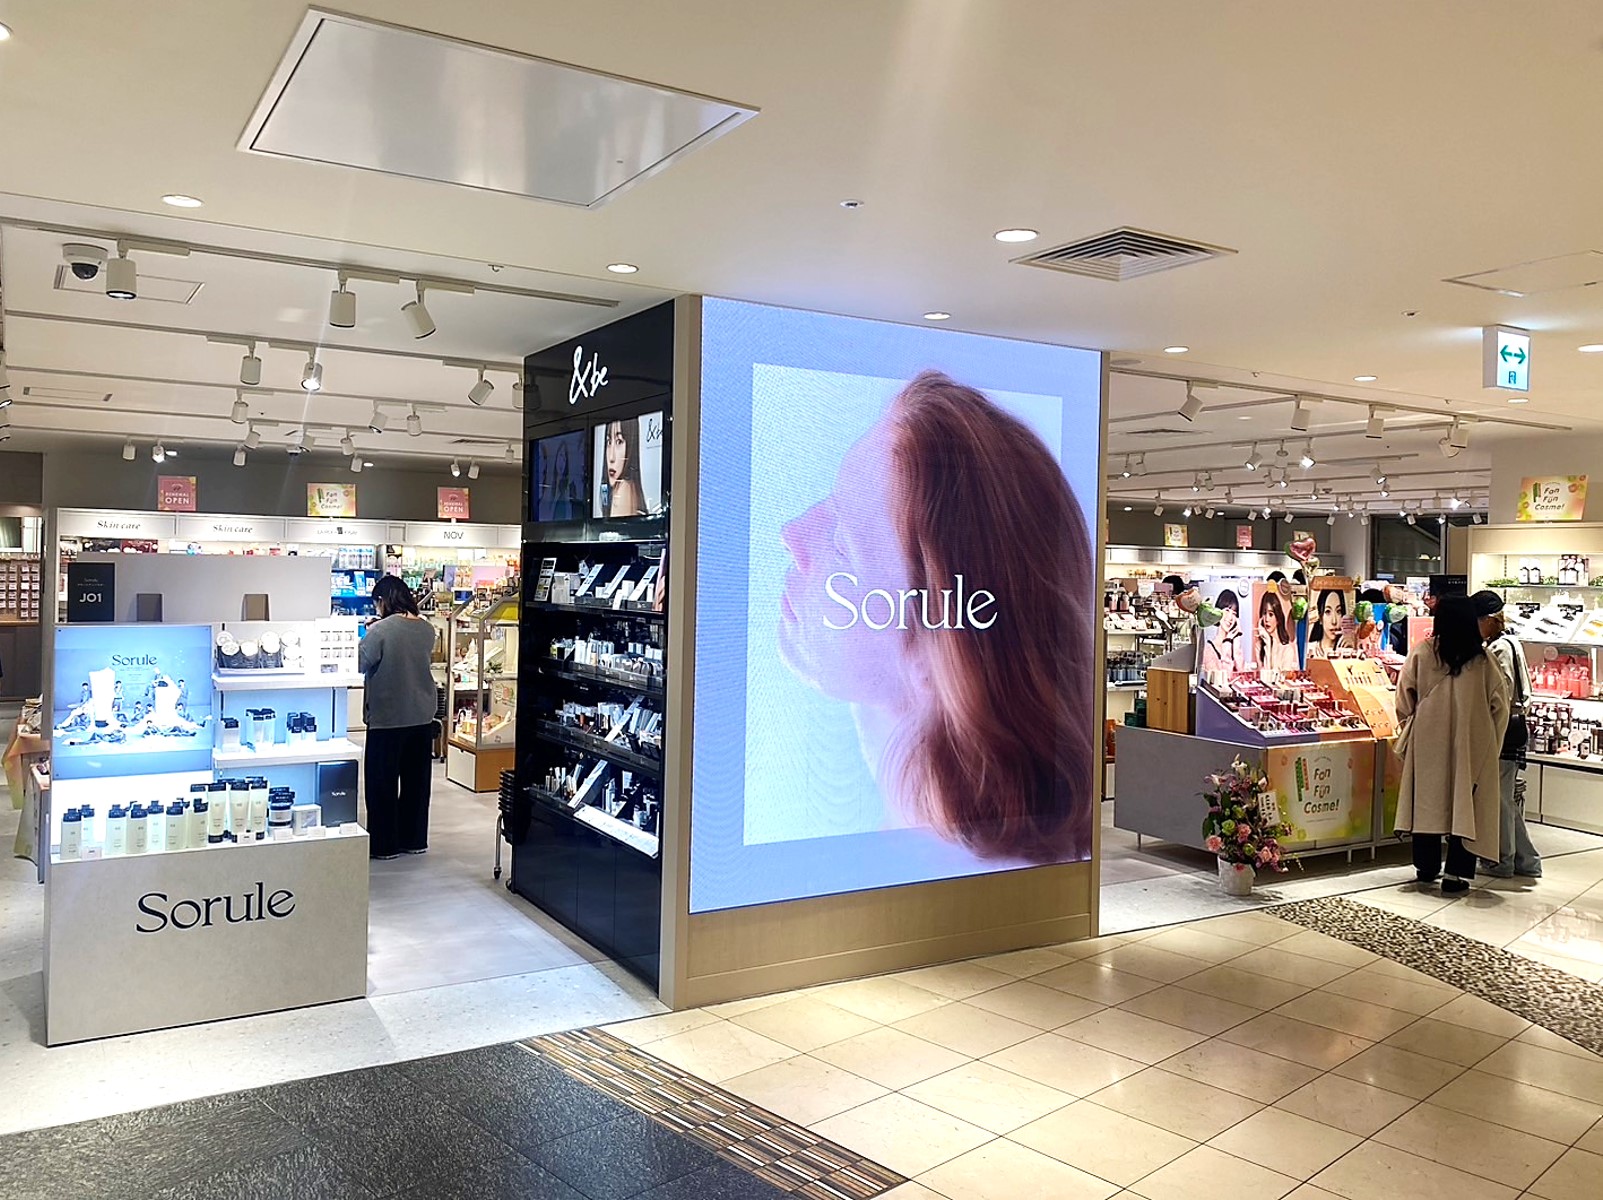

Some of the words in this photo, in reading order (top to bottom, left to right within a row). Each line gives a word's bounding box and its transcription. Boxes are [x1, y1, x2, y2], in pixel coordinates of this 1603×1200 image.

[569, 345, 608, 404] &be
[97, 519, 119, 529] Skin
[213, 524, 233, 532] Skin
[443, 531, 464, 540] NOV
[79, 592, 102, 603] JO1
[823, 571, 998, 630] Sorule
[111, 653, 158, 666] Sorule
[1313, 768, 1331, 780] Fan
[1303, 799, 1340, 815] Cosme!
[136, 881, 296, 933] Sorule
